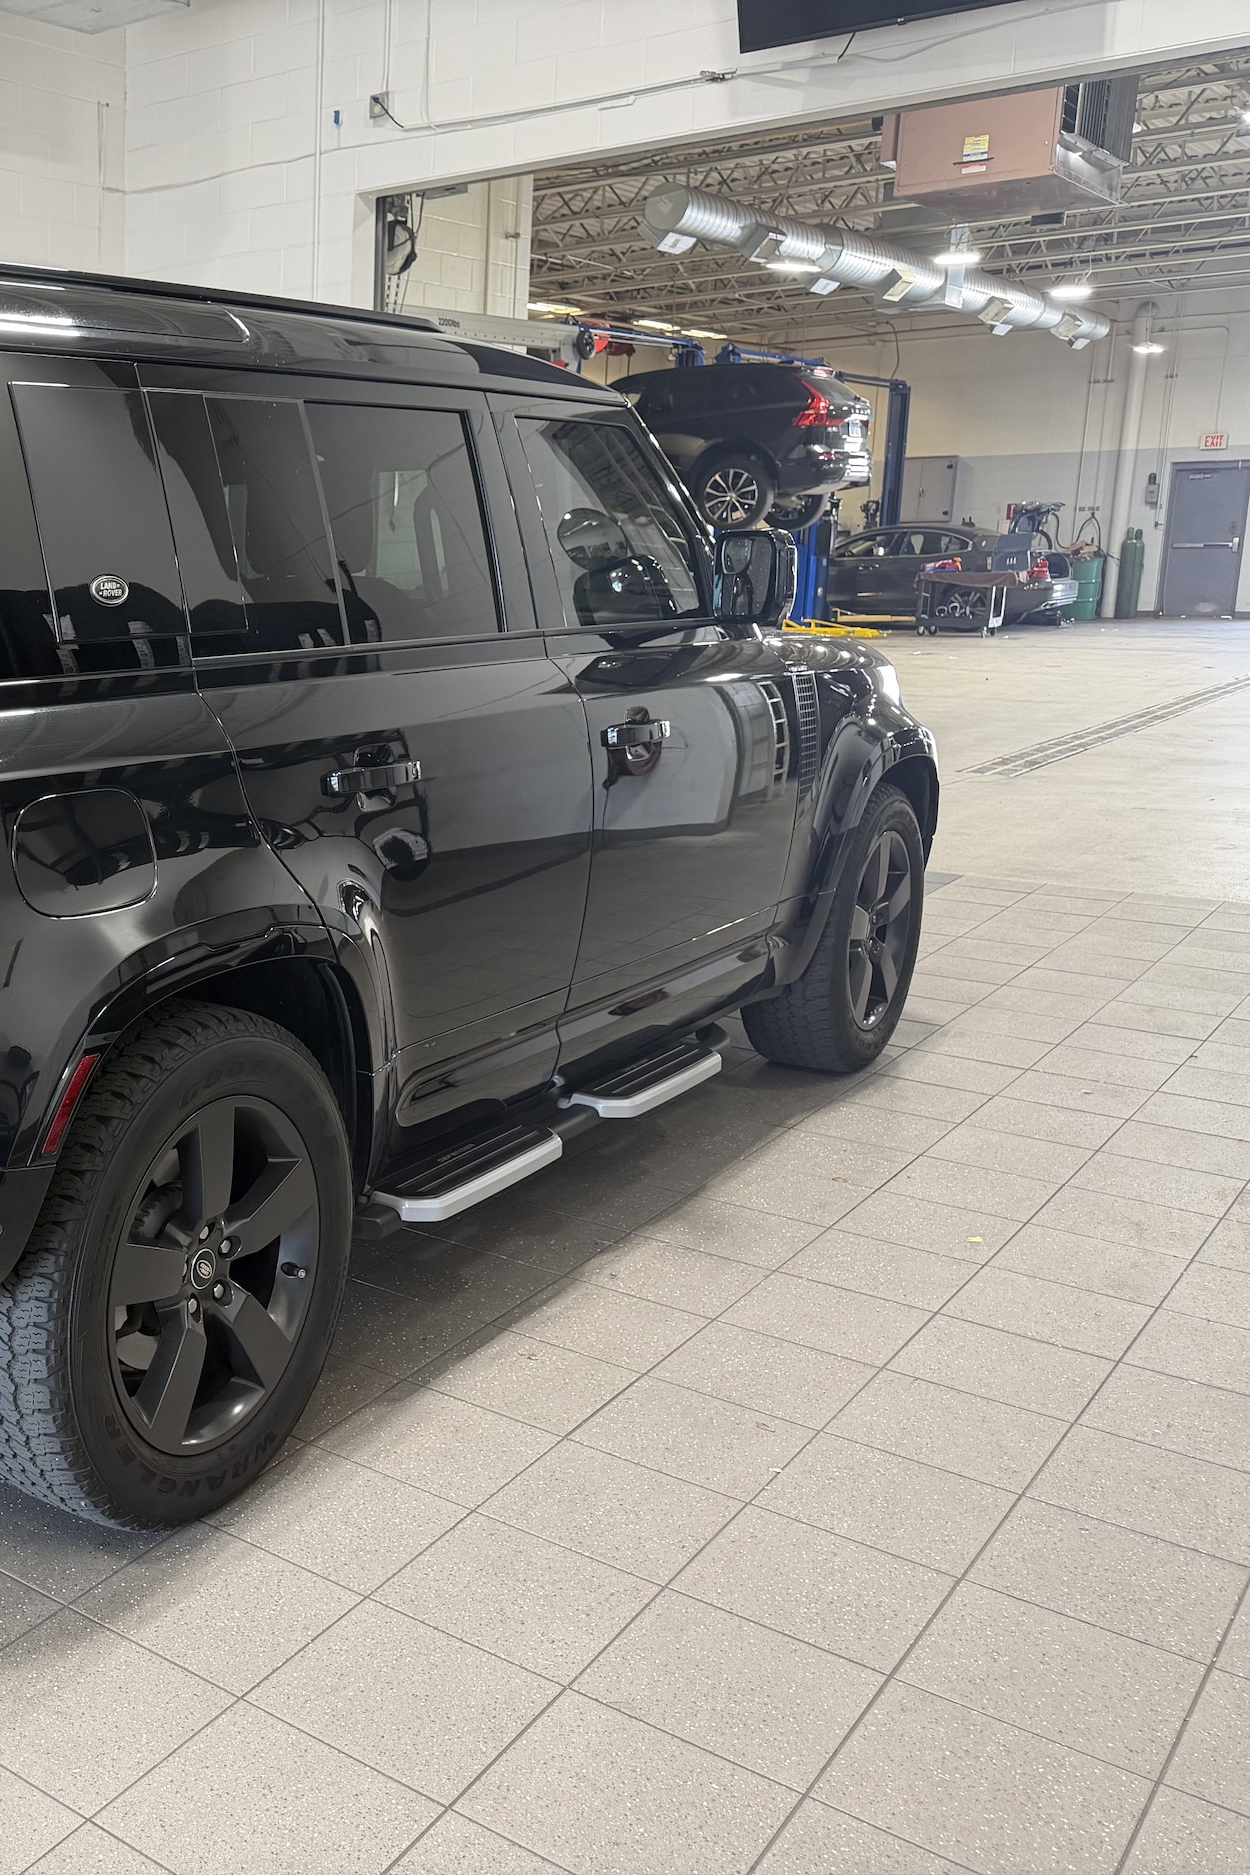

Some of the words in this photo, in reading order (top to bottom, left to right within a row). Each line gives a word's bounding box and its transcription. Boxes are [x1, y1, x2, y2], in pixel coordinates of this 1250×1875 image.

[1204, 435, 1224, 448] EXIT
[100, 581, 117, 590] LAND
[102, 588, 123, 598] ROVER
